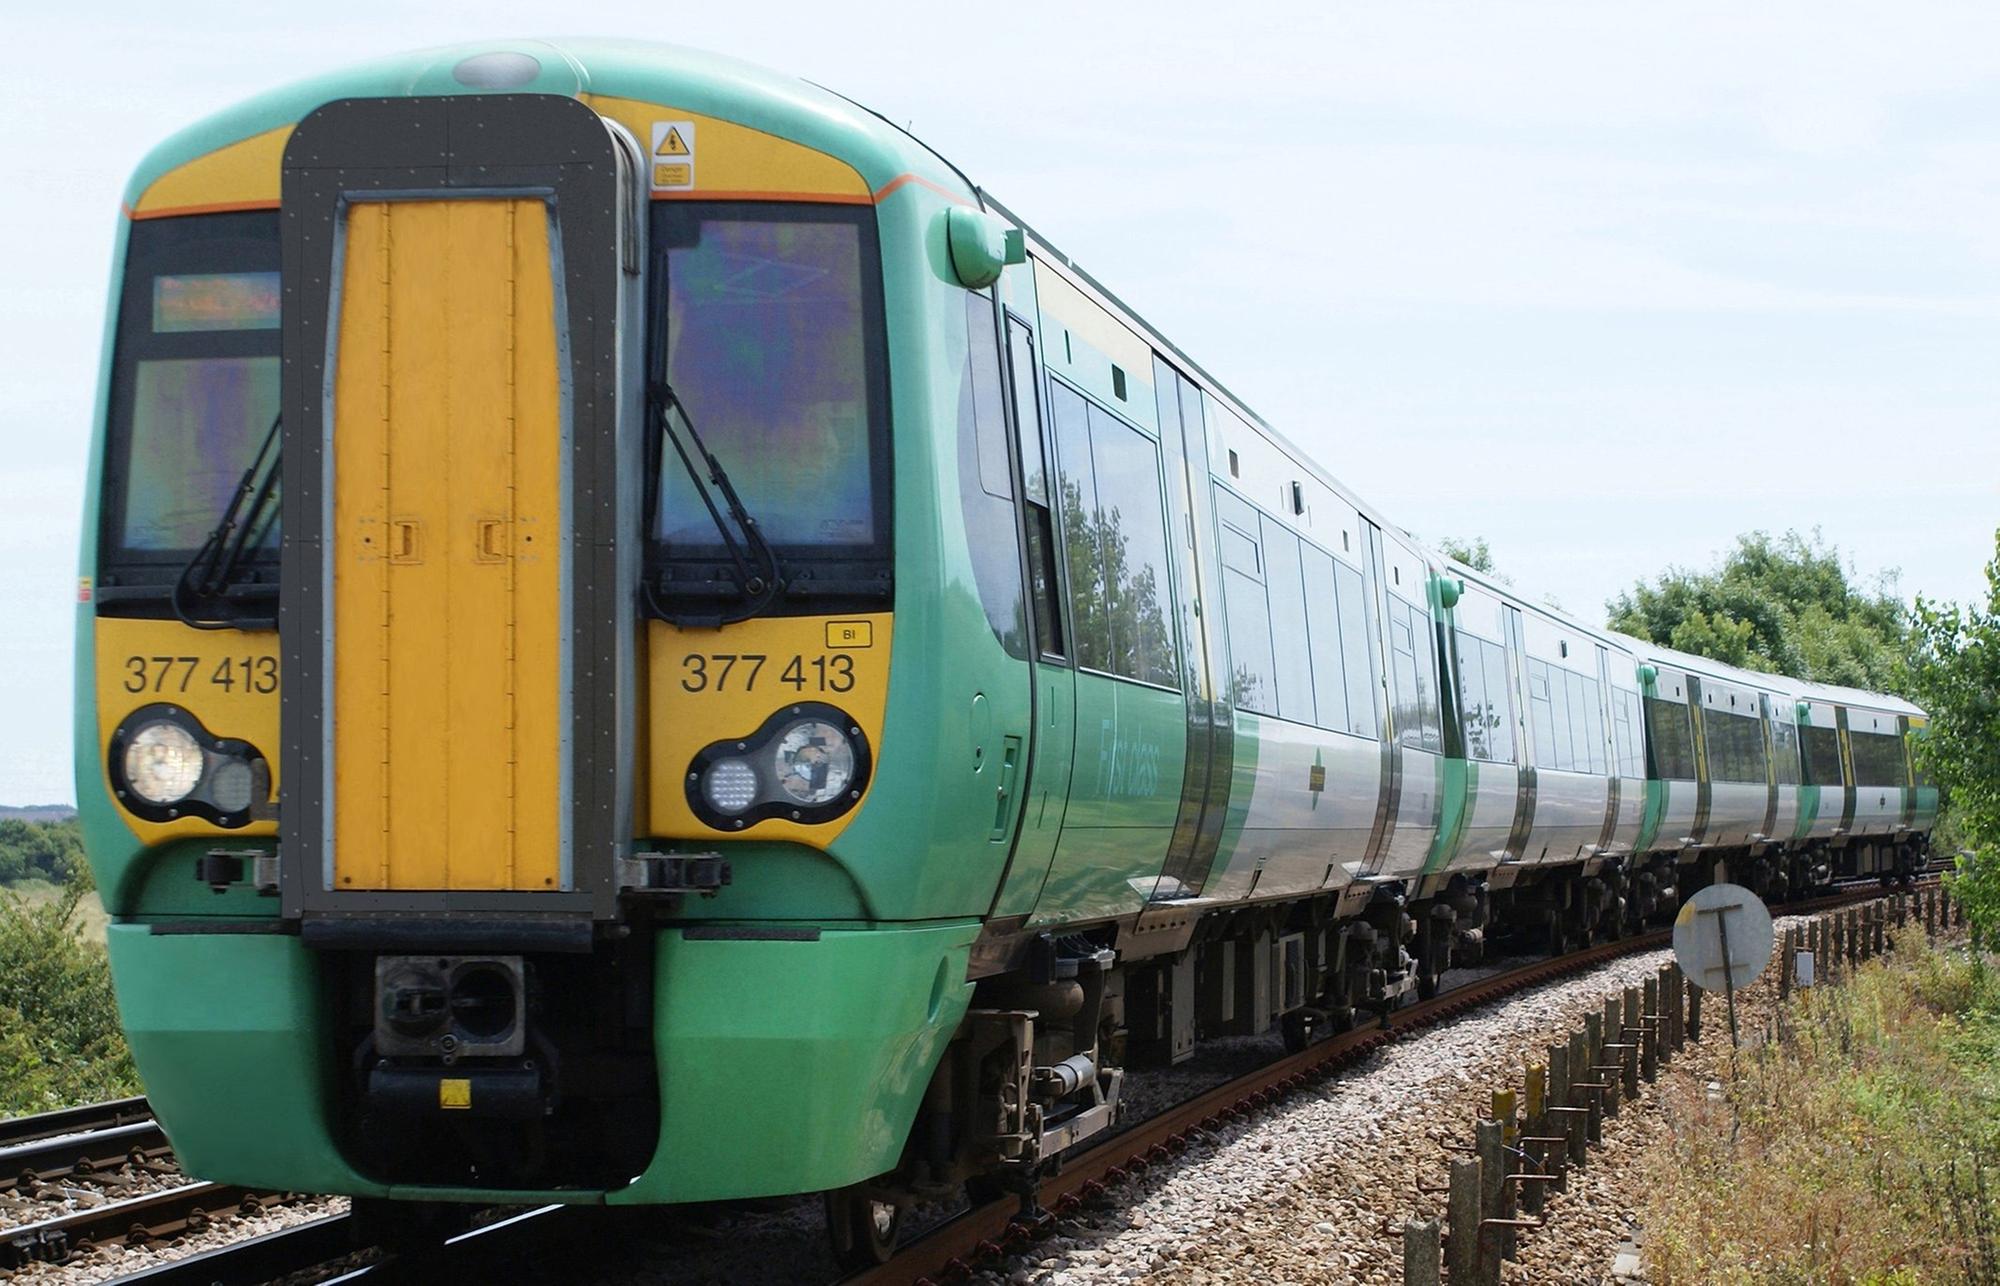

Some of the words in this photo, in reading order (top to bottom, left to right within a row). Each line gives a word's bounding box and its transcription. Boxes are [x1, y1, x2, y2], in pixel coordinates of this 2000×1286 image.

[123, 655, 200, 693] 377
[211, 655, 278, 694] 413
[681, 653, 766, 692] 377
[780, 653, 856, 692] 413
[1096, 720, 1128, 796] Fist
